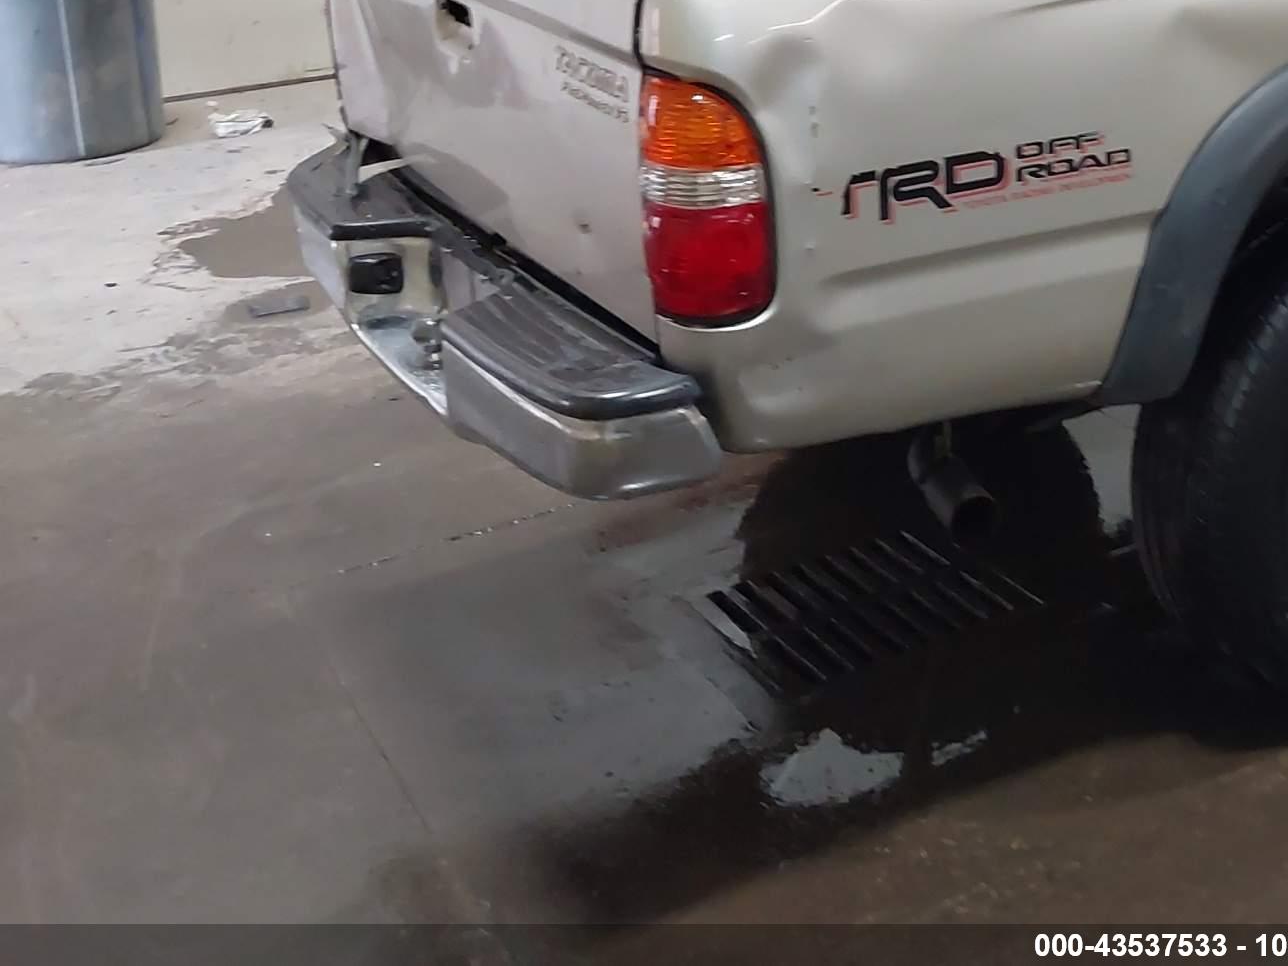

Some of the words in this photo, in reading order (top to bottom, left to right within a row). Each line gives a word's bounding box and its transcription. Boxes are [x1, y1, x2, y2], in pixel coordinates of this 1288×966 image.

[1016, 131, 1104, 160] OFF
[1015, 148, 1133, 183] ROAD
[838, 149, 1010, 224] TRD
